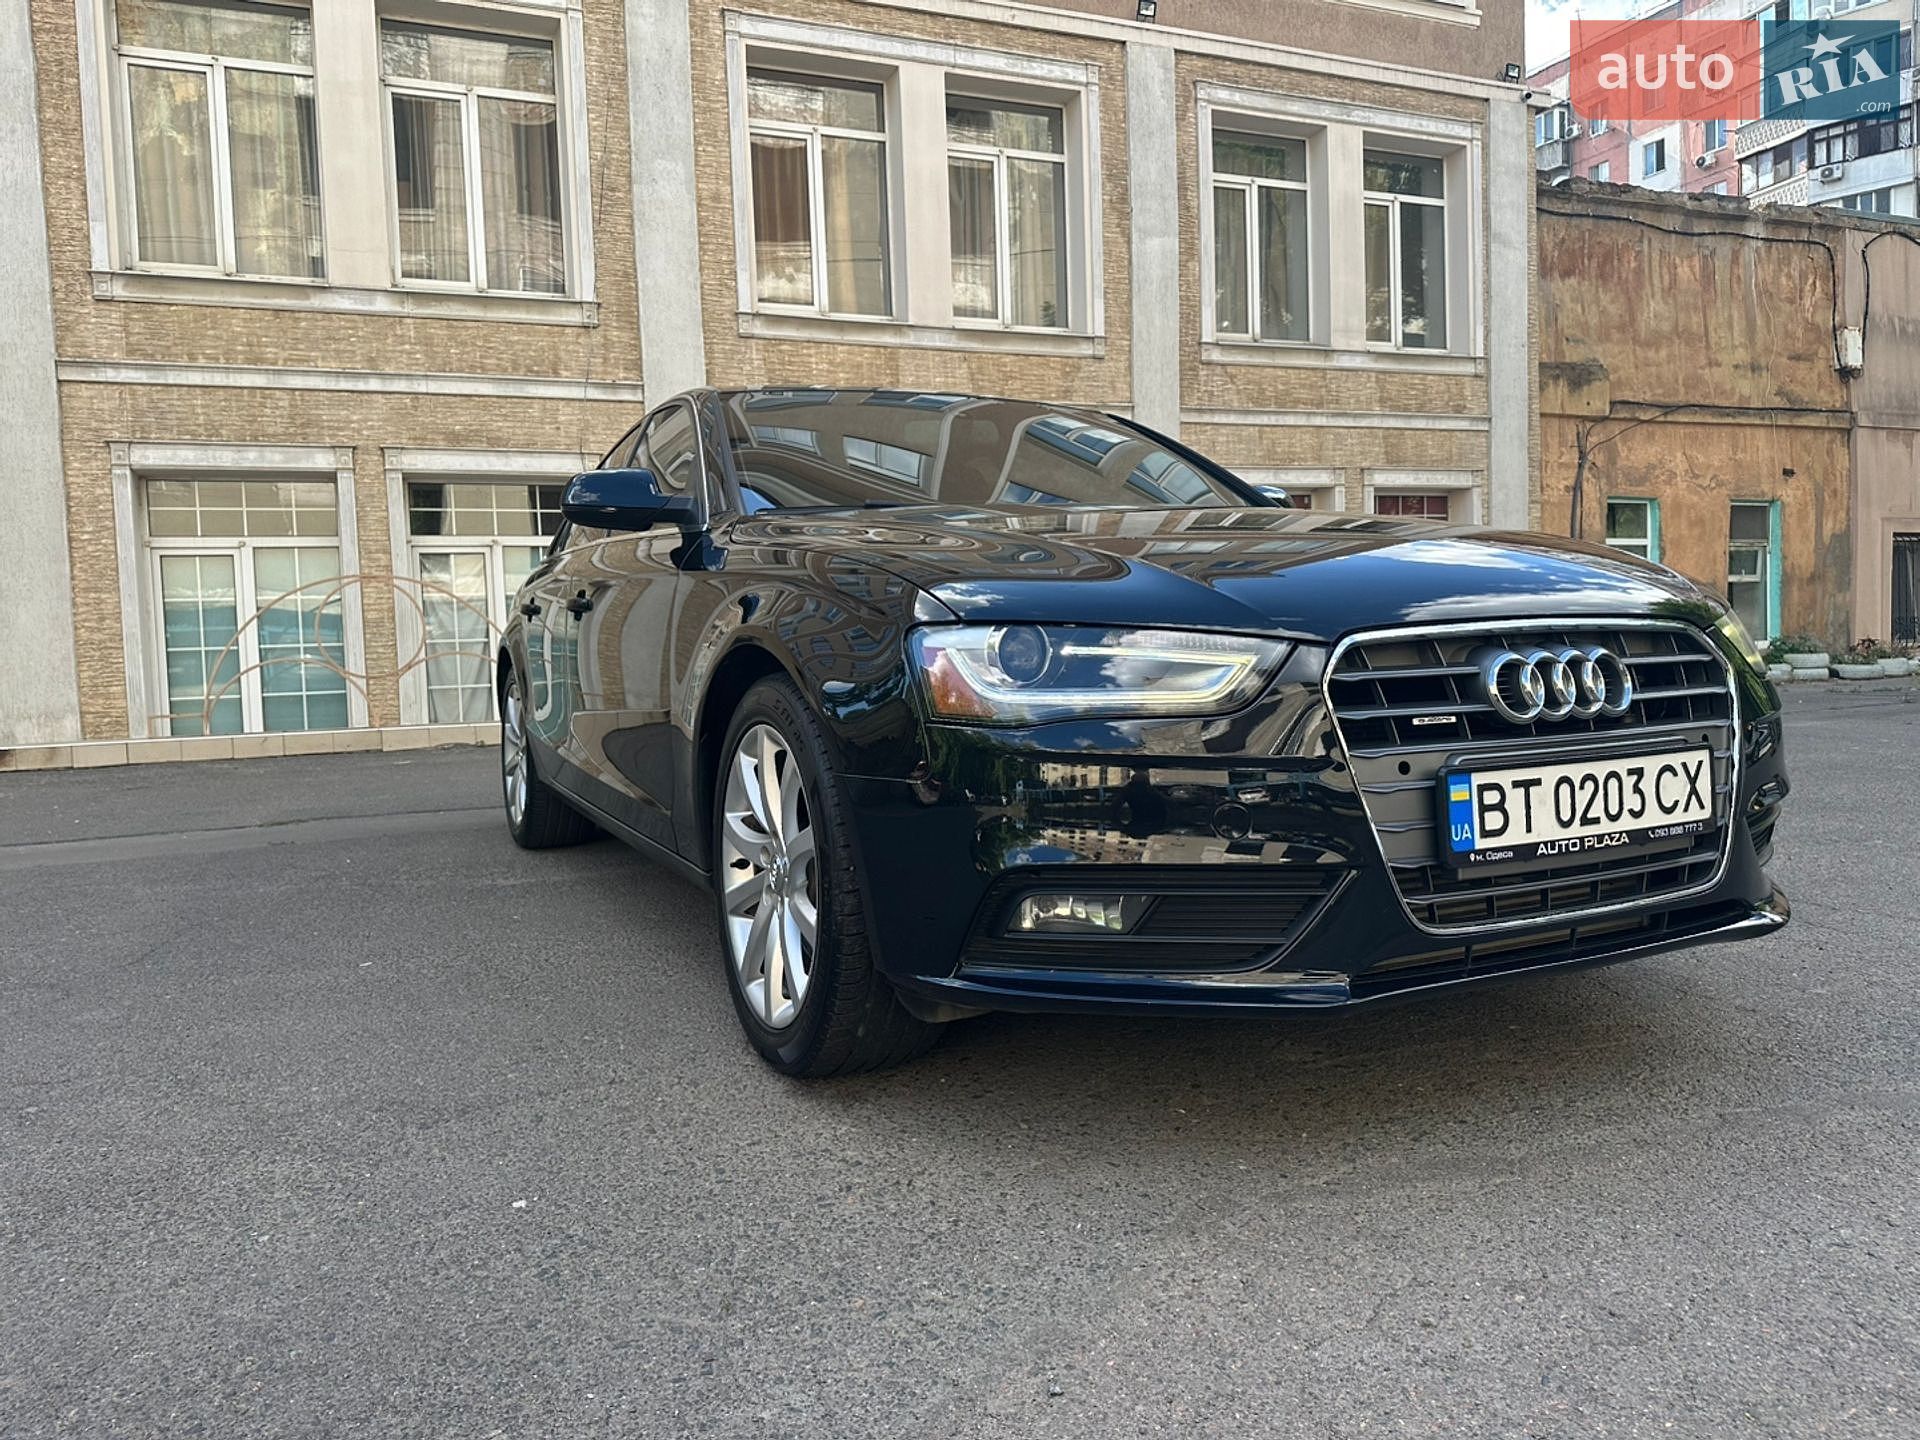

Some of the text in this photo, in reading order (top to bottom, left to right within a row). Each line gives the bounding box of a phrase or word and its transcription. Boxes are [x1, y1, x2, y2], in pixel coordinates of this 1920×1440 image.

[1477, 760, 1705, 839] BT 0203 CX
[1451, 823, 1472, 841] UA
[1537, 833, 1629, 856] AUTO PLAZA
